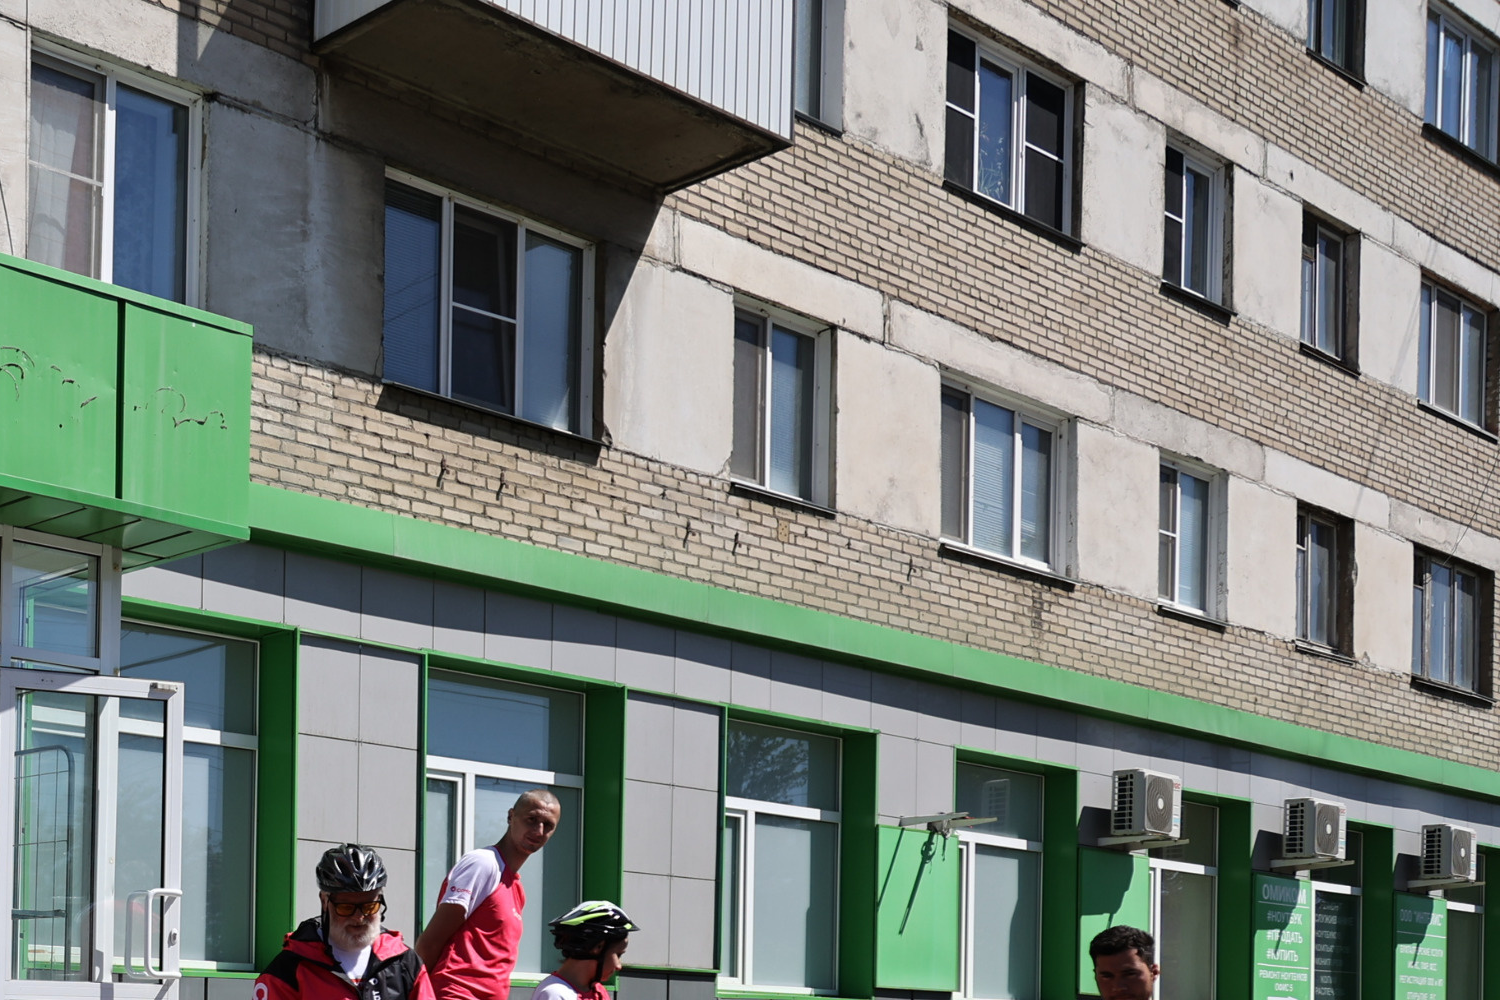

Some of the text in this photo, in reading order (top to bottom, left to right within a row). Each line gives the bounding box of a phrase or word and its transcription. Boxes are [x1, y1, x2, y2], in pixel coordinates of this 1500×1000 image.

[1261, 883, 1307, 904] ОМИКОМ
[1266, 930, 1304, 945] #ПРОДАТЬ
[1266, 948, 1299, 963] #КУПИТЬ
